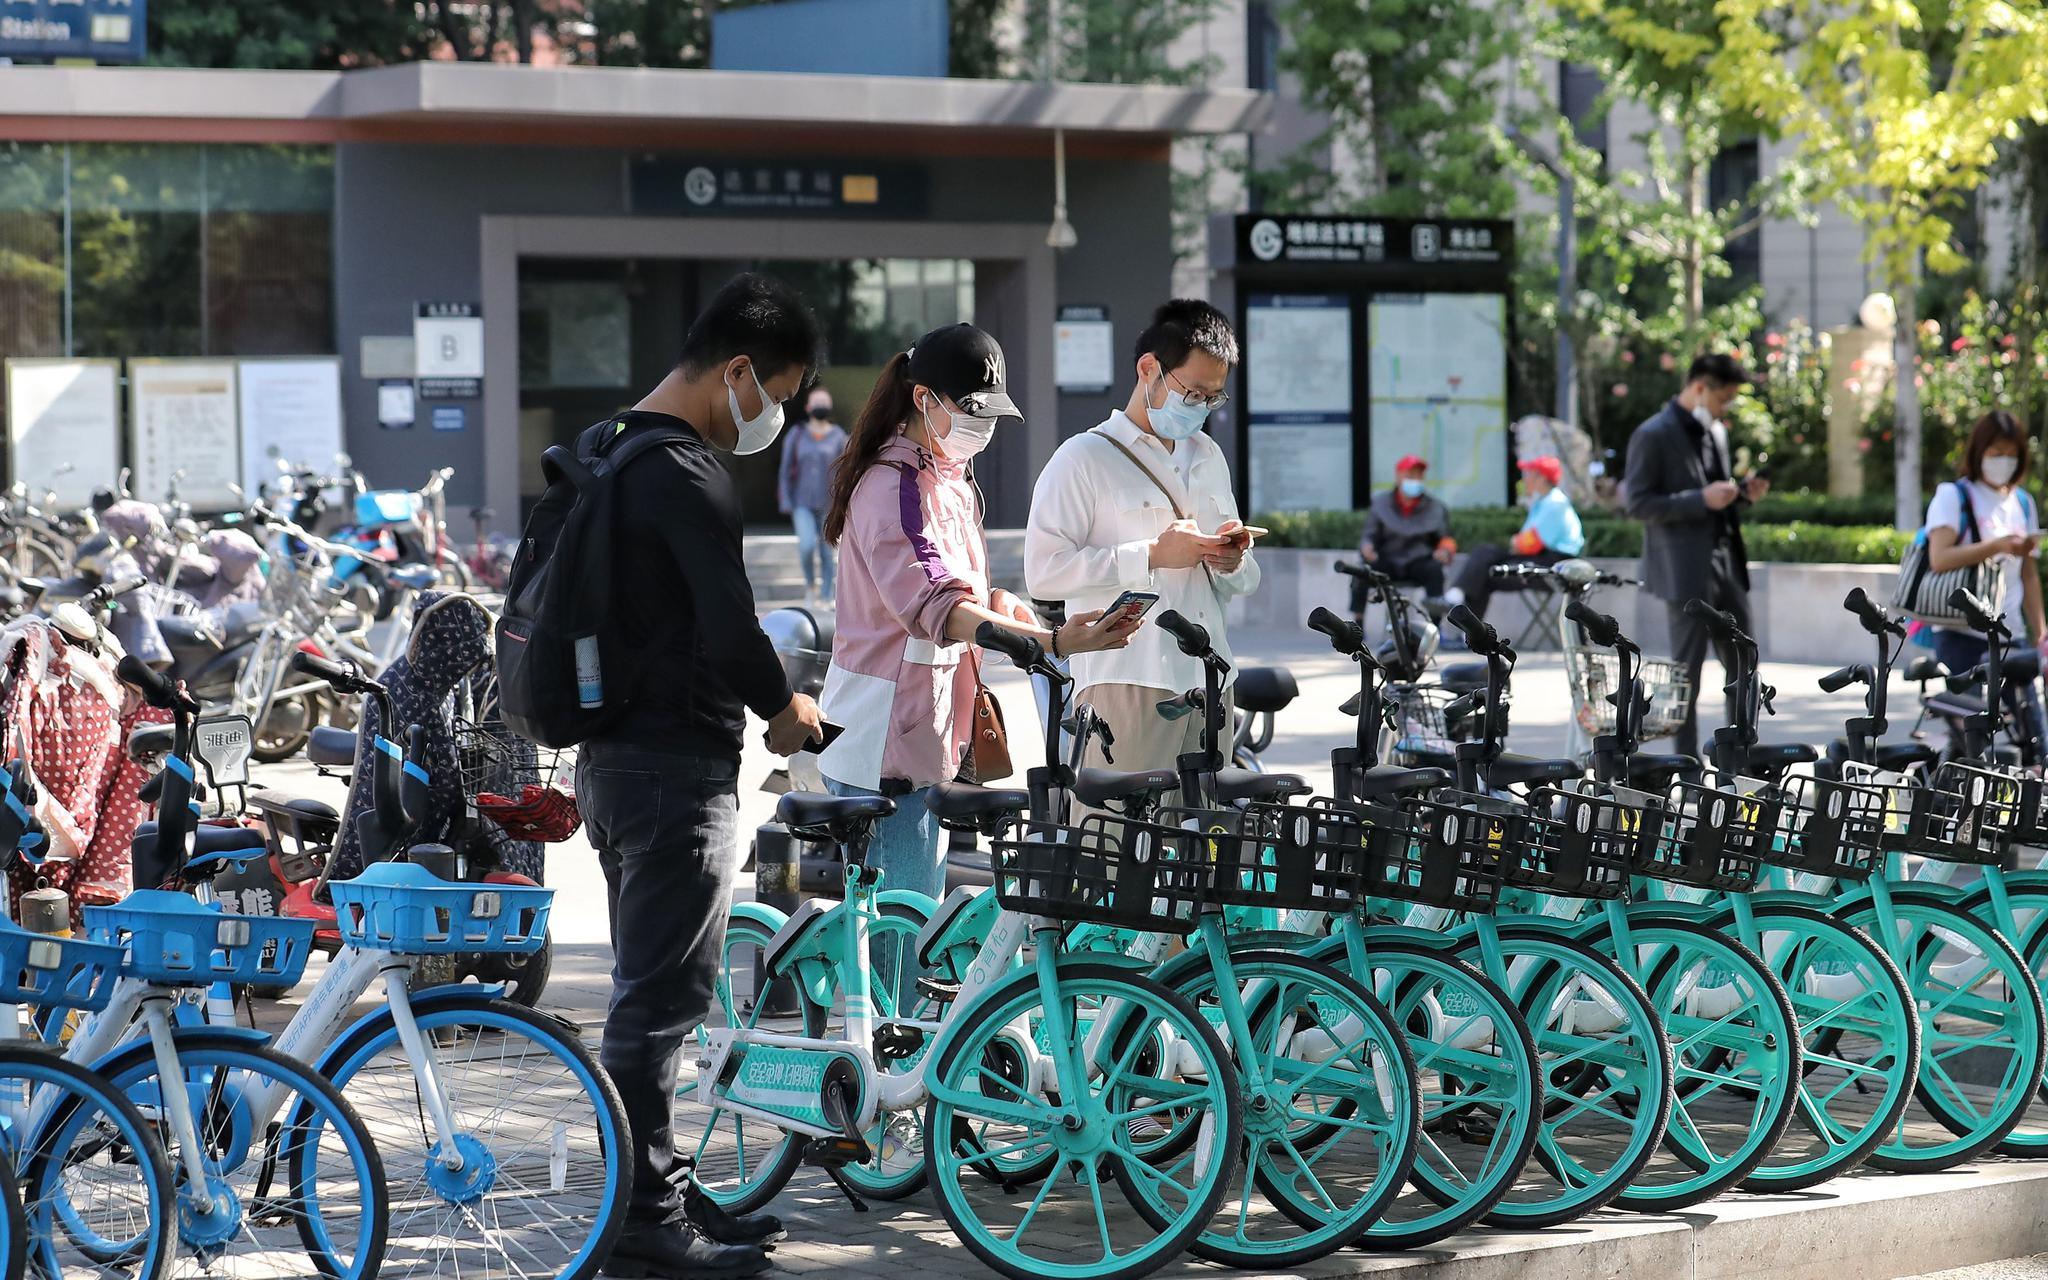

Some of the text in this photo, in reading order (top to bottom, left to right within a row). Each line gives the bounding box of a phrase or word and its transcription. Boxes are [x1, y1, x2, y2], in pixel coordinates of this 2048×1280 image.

[0, 16, 70, 40] Station
[440, 334, 458, 361] B
[983, 353, 1003, 384] NY
